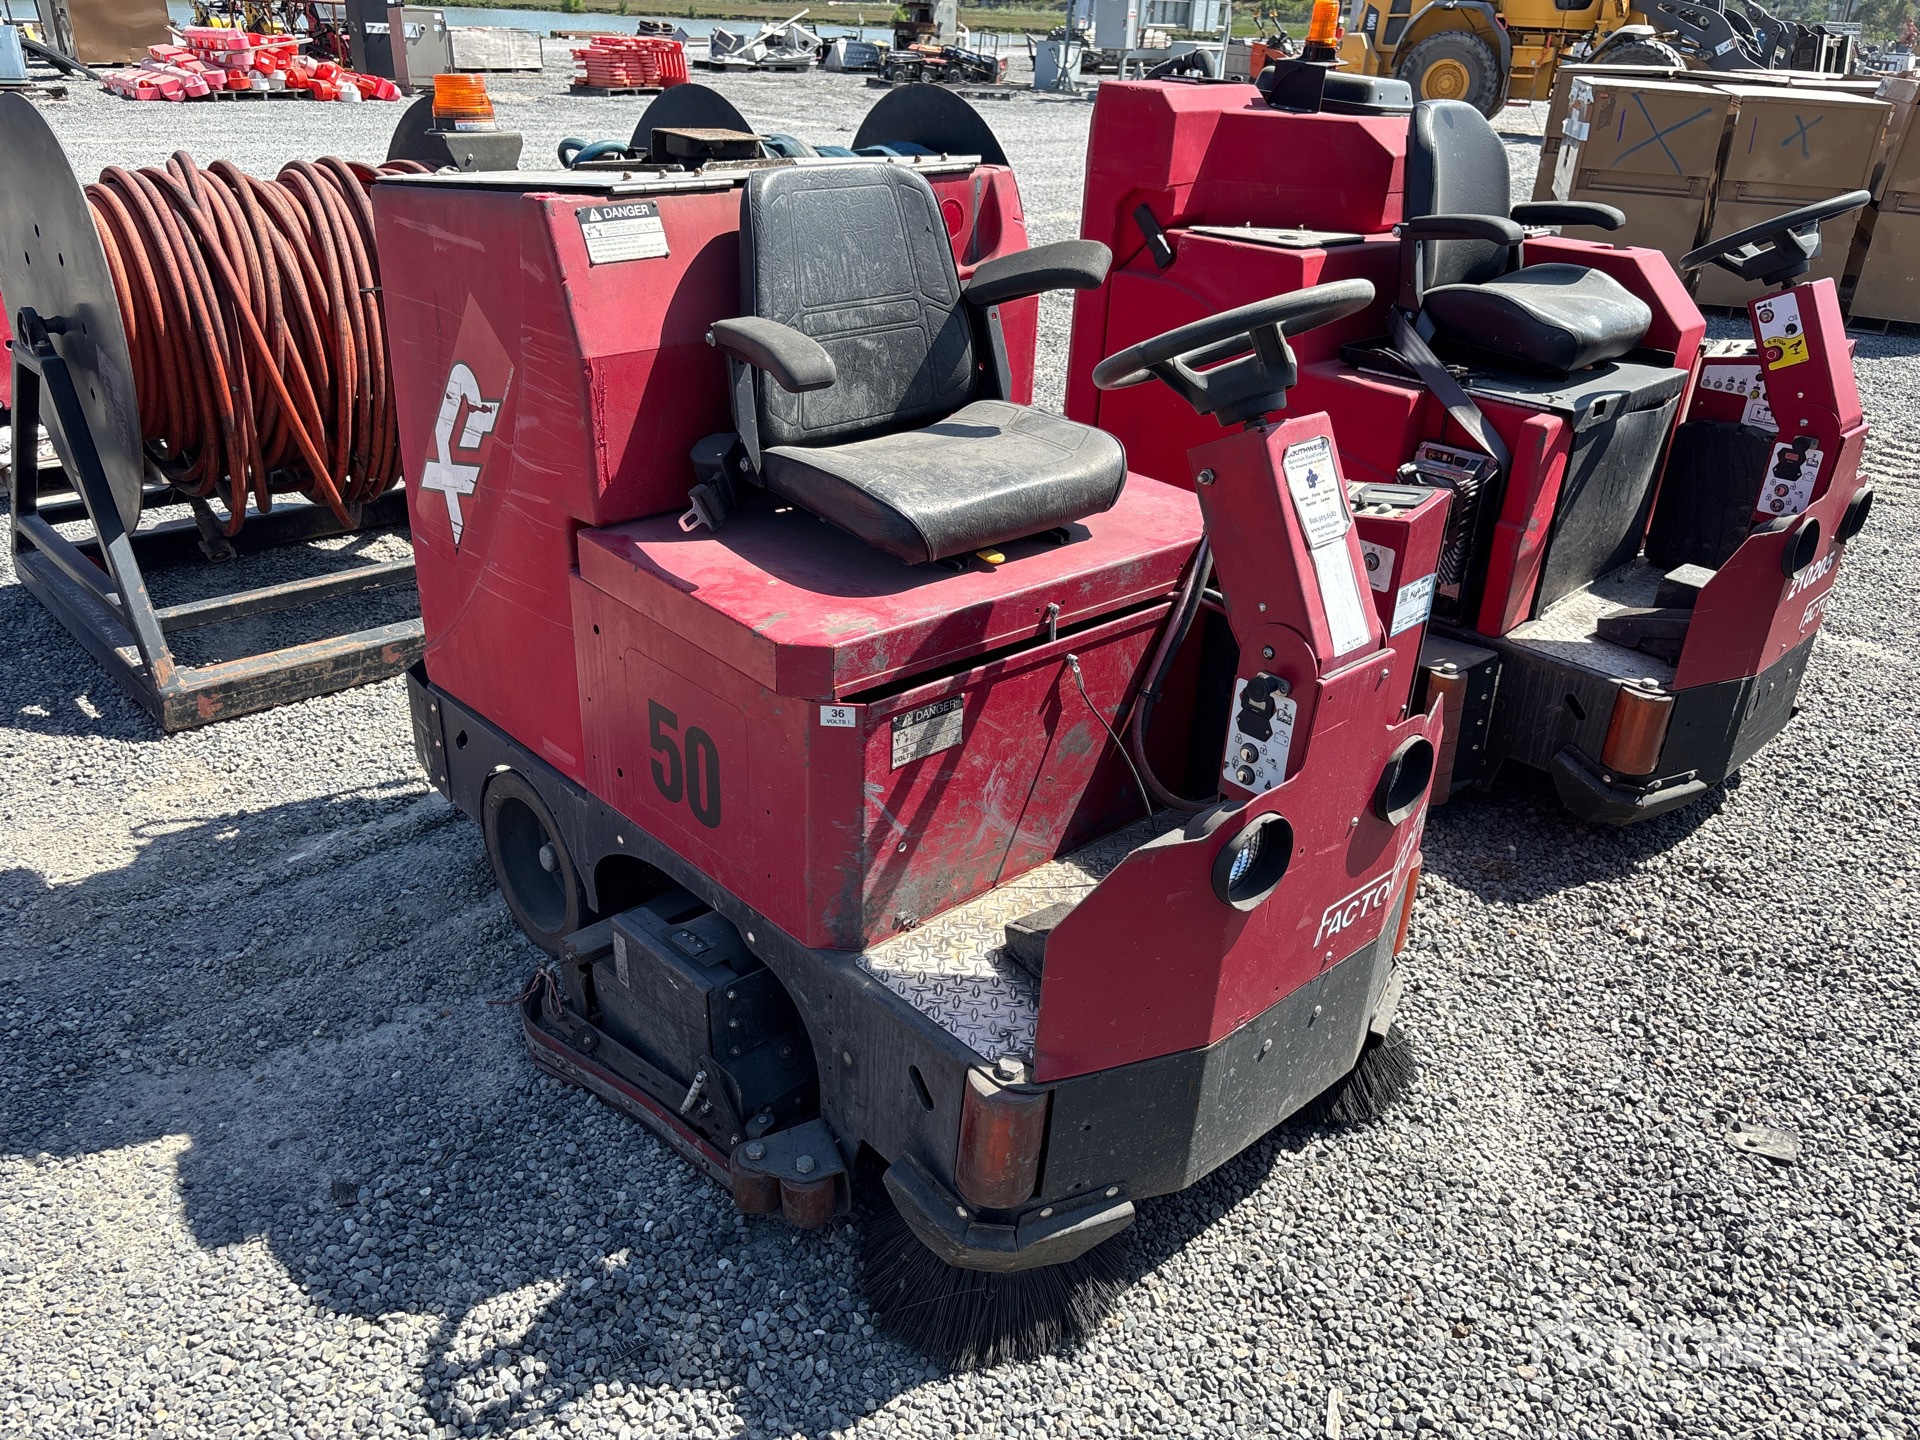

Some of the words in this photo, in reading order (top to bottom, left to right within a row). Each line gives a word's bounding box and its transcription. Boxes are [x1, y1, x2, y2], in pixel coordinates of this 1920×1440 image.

[603, 205, 650, 219] DANGER
[1767, 338, 1787, 346] E-STOP
[1287, 442, 1325, 458] OUTHWEST
[1786, 550, 1836, 602] 210205
[831, 709, 845, 718] 36
[916, 700, 955, 720] DANGER
[648, 698, 722, 829] 50
